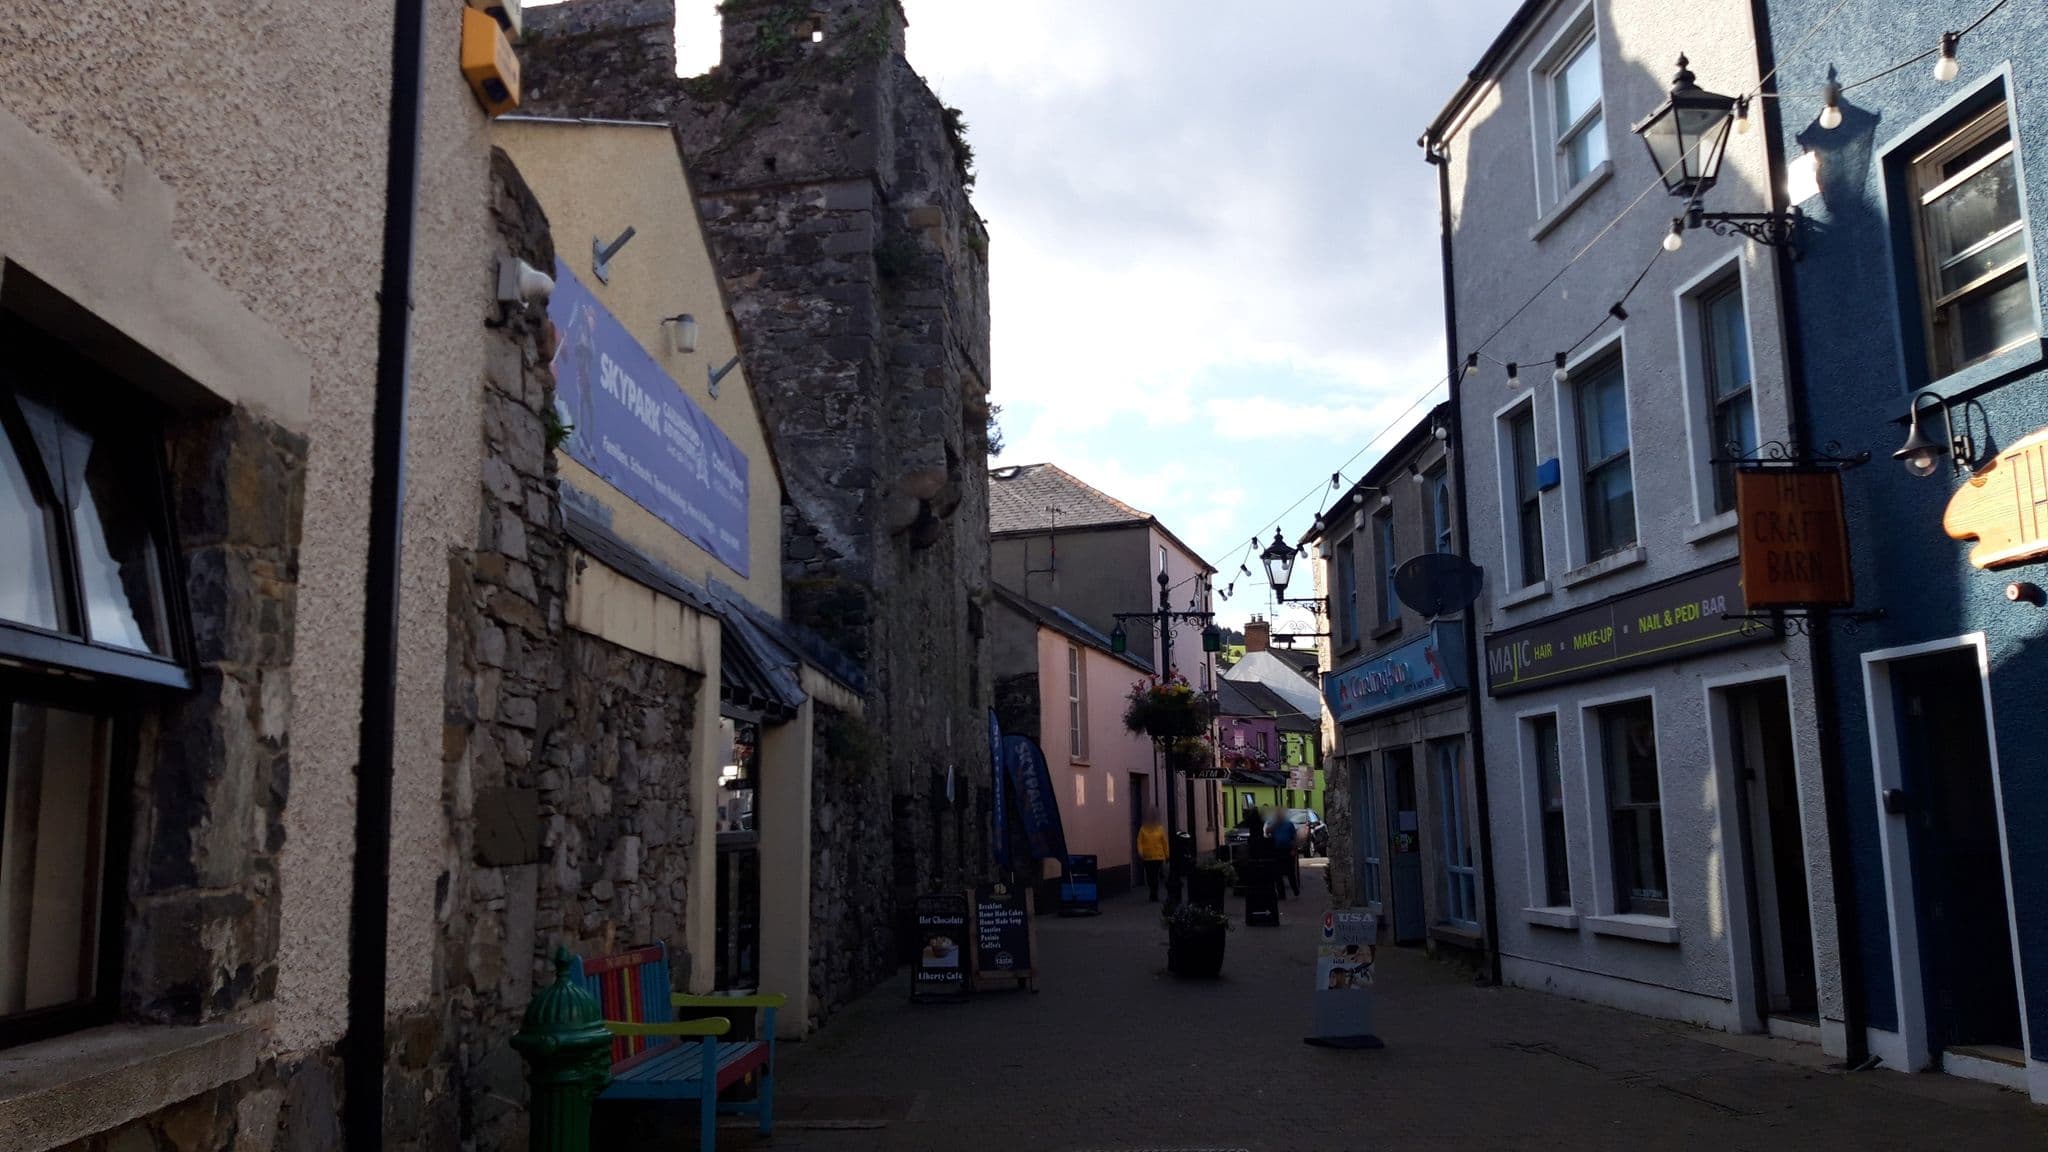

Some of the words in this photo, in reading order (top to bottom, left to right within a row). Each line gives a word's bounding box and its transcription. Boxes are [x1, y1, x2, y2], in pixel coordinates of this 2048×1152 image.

[600, 352, 661, 437] SKYPARK
[1774, 474, 1813, 504] THE
[1754, 511, 1830, 543] CRAFT
[1767, 550, 1825, 584] BARN
[1489, 640, 1531, 682] MAJIC
[1534, 643, 1553, 660] HAIR
[1573, 626, 1613, 651] MAKE-UP
[1639, 613, 1662, 634] NAIL
[1664, 609, 1673, 627] &
[1674, 602, 1700, 624] PEDI
[1702, 595, 1726, 617] BAR
[1014, 741, 1049, 828] SKYPARK
[1199, 769, 1218, 778] ATM
[1337, 912, 1374, 921] USA
[918, 971, 945, 981] Liberty
